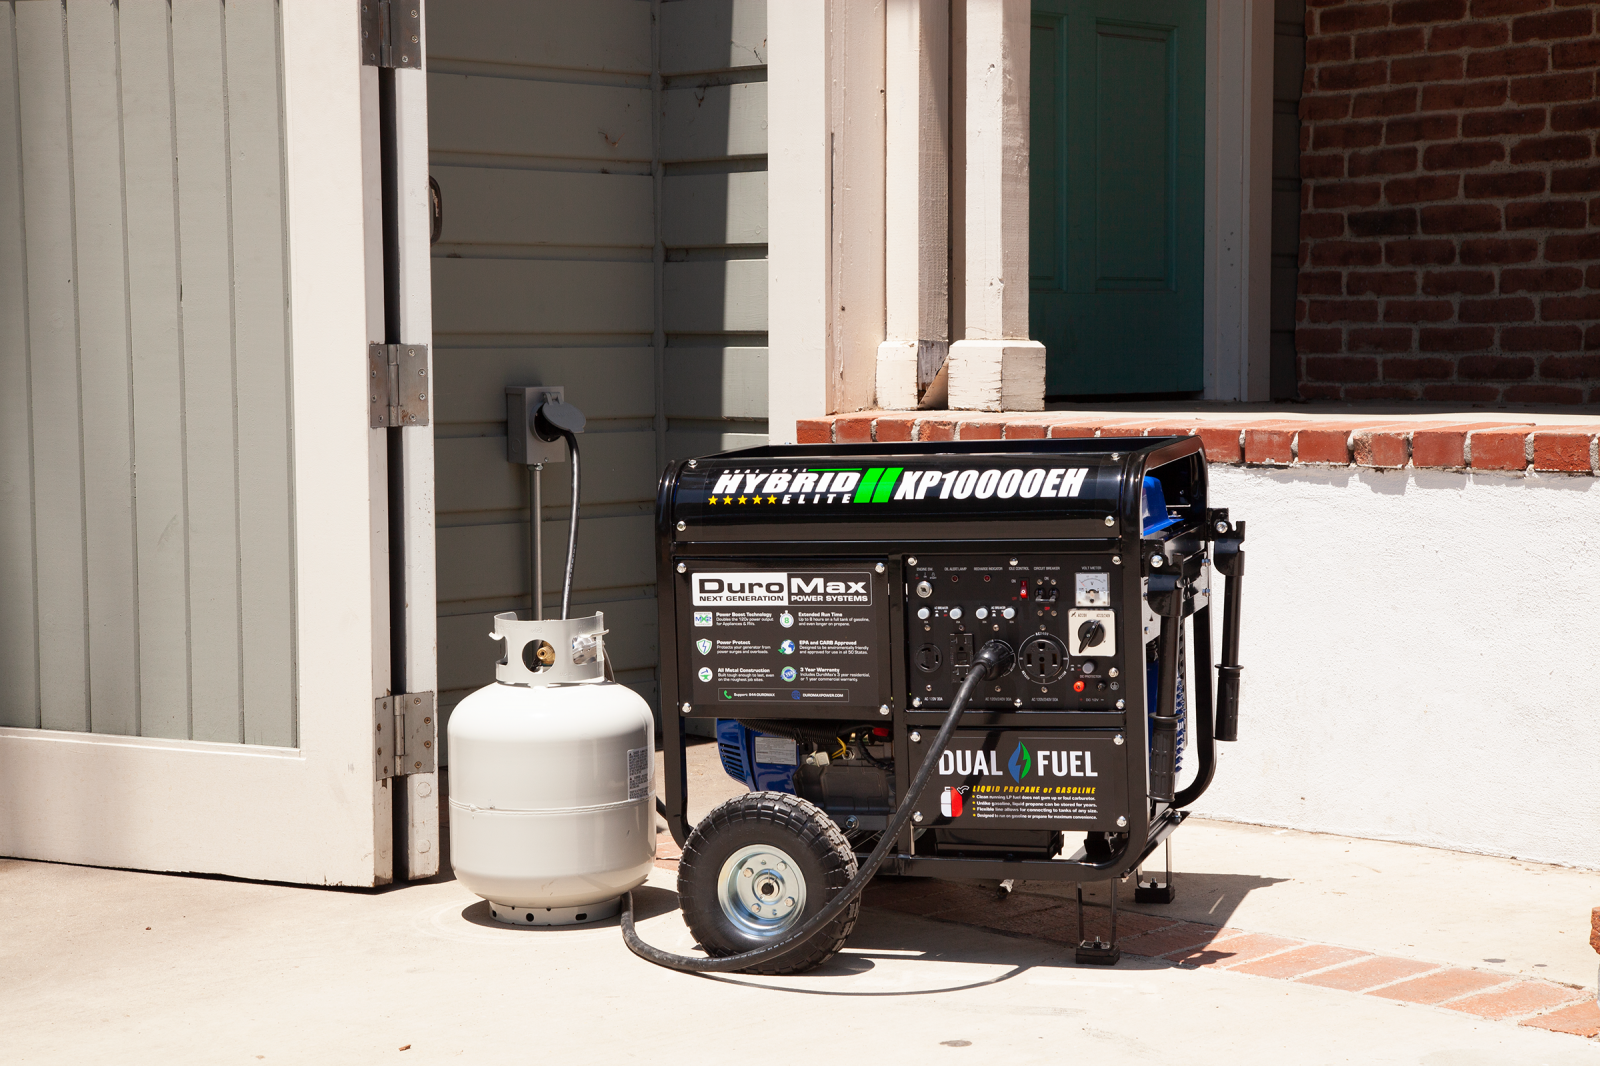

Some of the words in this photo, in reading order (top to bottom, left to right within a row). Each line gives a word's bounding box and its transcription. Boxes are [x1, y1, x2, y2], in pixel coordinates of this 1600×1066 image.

[712, 472, 861, 494] HYBRID
[893, 468, 1089, 500] XP10000EH
[782, 494, 852, 504] ELITE
[938, 750, 1003, 776] DUAL
[1037, 750, 1098, 777] FUEL
[1056, 786, 1096, 794] GASOLINE
